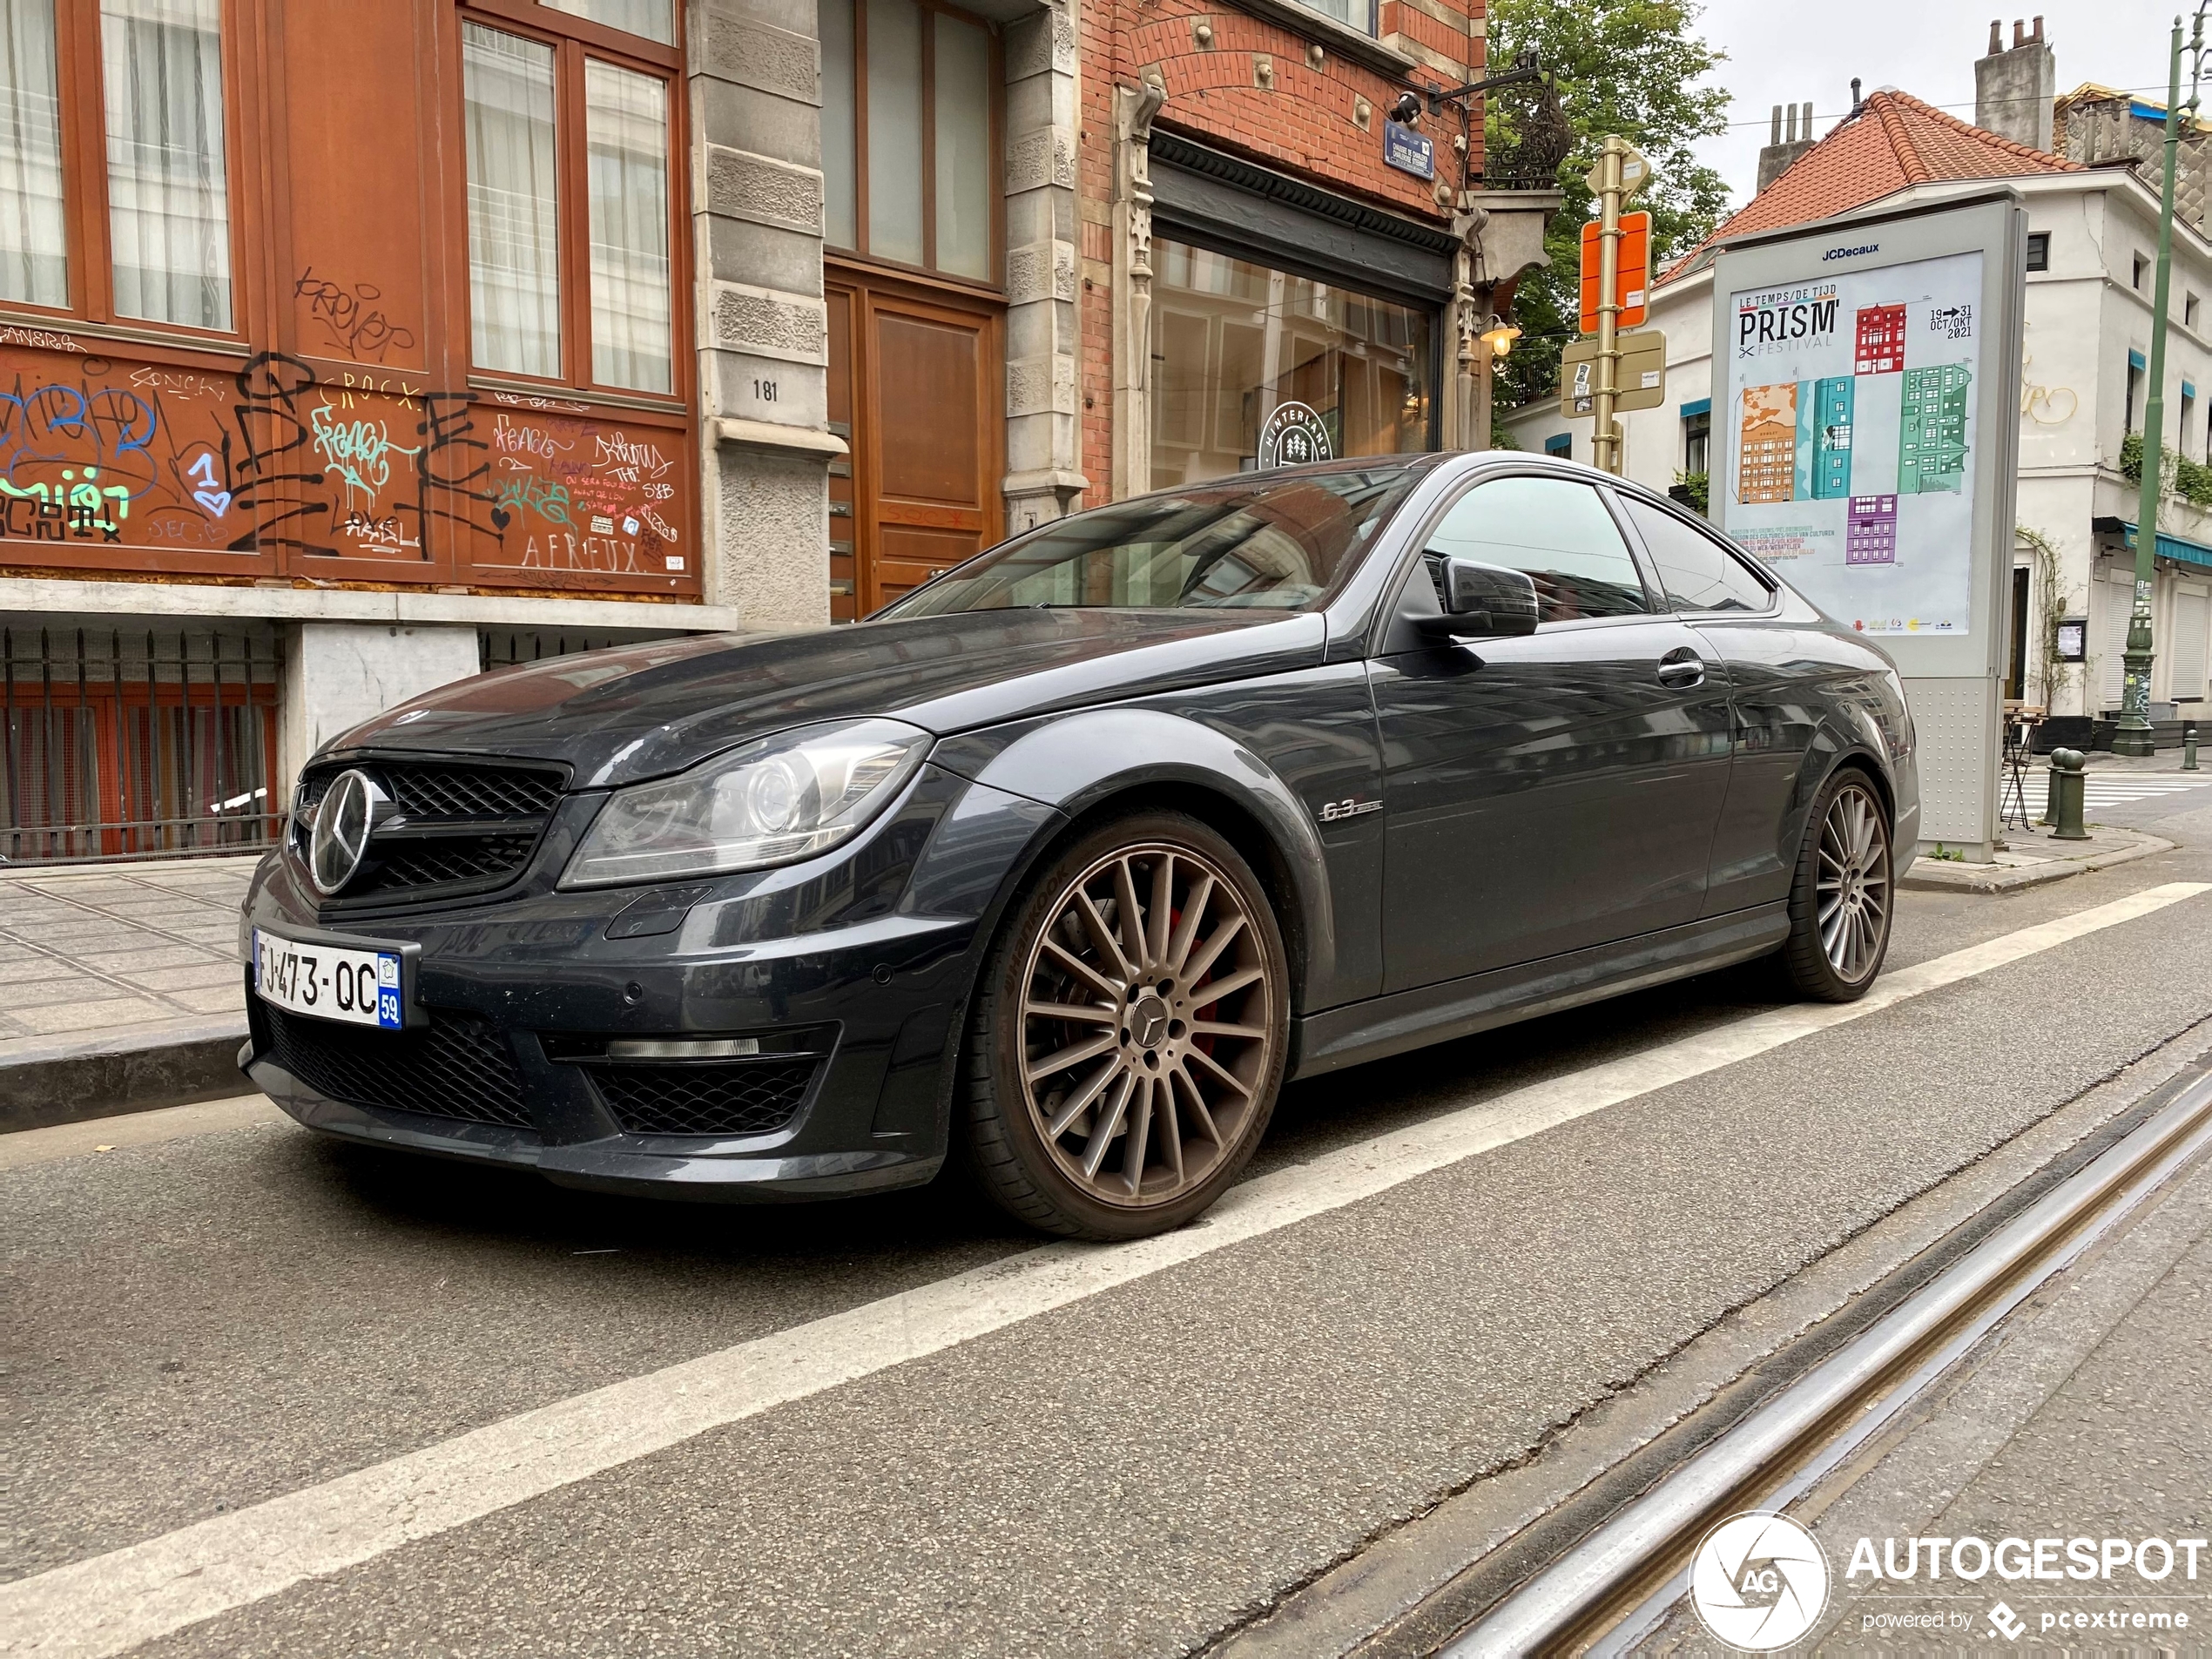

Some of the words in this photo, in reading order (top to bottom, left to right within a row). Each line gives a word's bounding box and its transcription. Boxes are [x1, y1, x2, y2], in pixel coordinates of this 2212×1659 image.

[1822, 244, 1879, 261] JCDecaux
[1740, 297, 1751, 309] LE
[1755, 288, 1809, 306] TEMPS/DE
[1812, 284, 1837, 297] TIJD
[1930, 316, 1973, 331] OCT/OKT
[1931, 309, 1942, 321] 19
[1960, 305, 1972, 317] 31
[1947, 327, 1972, 340] 2021
[1758, 335, 1832, 356] FESTIVAL
[753, 379, 778, 402] 181
[1265, 409, 1327, 455] HINTERLAND
[1323, 799, 1355, 822] 6.3
[381, 994, 400, 1024] 59
